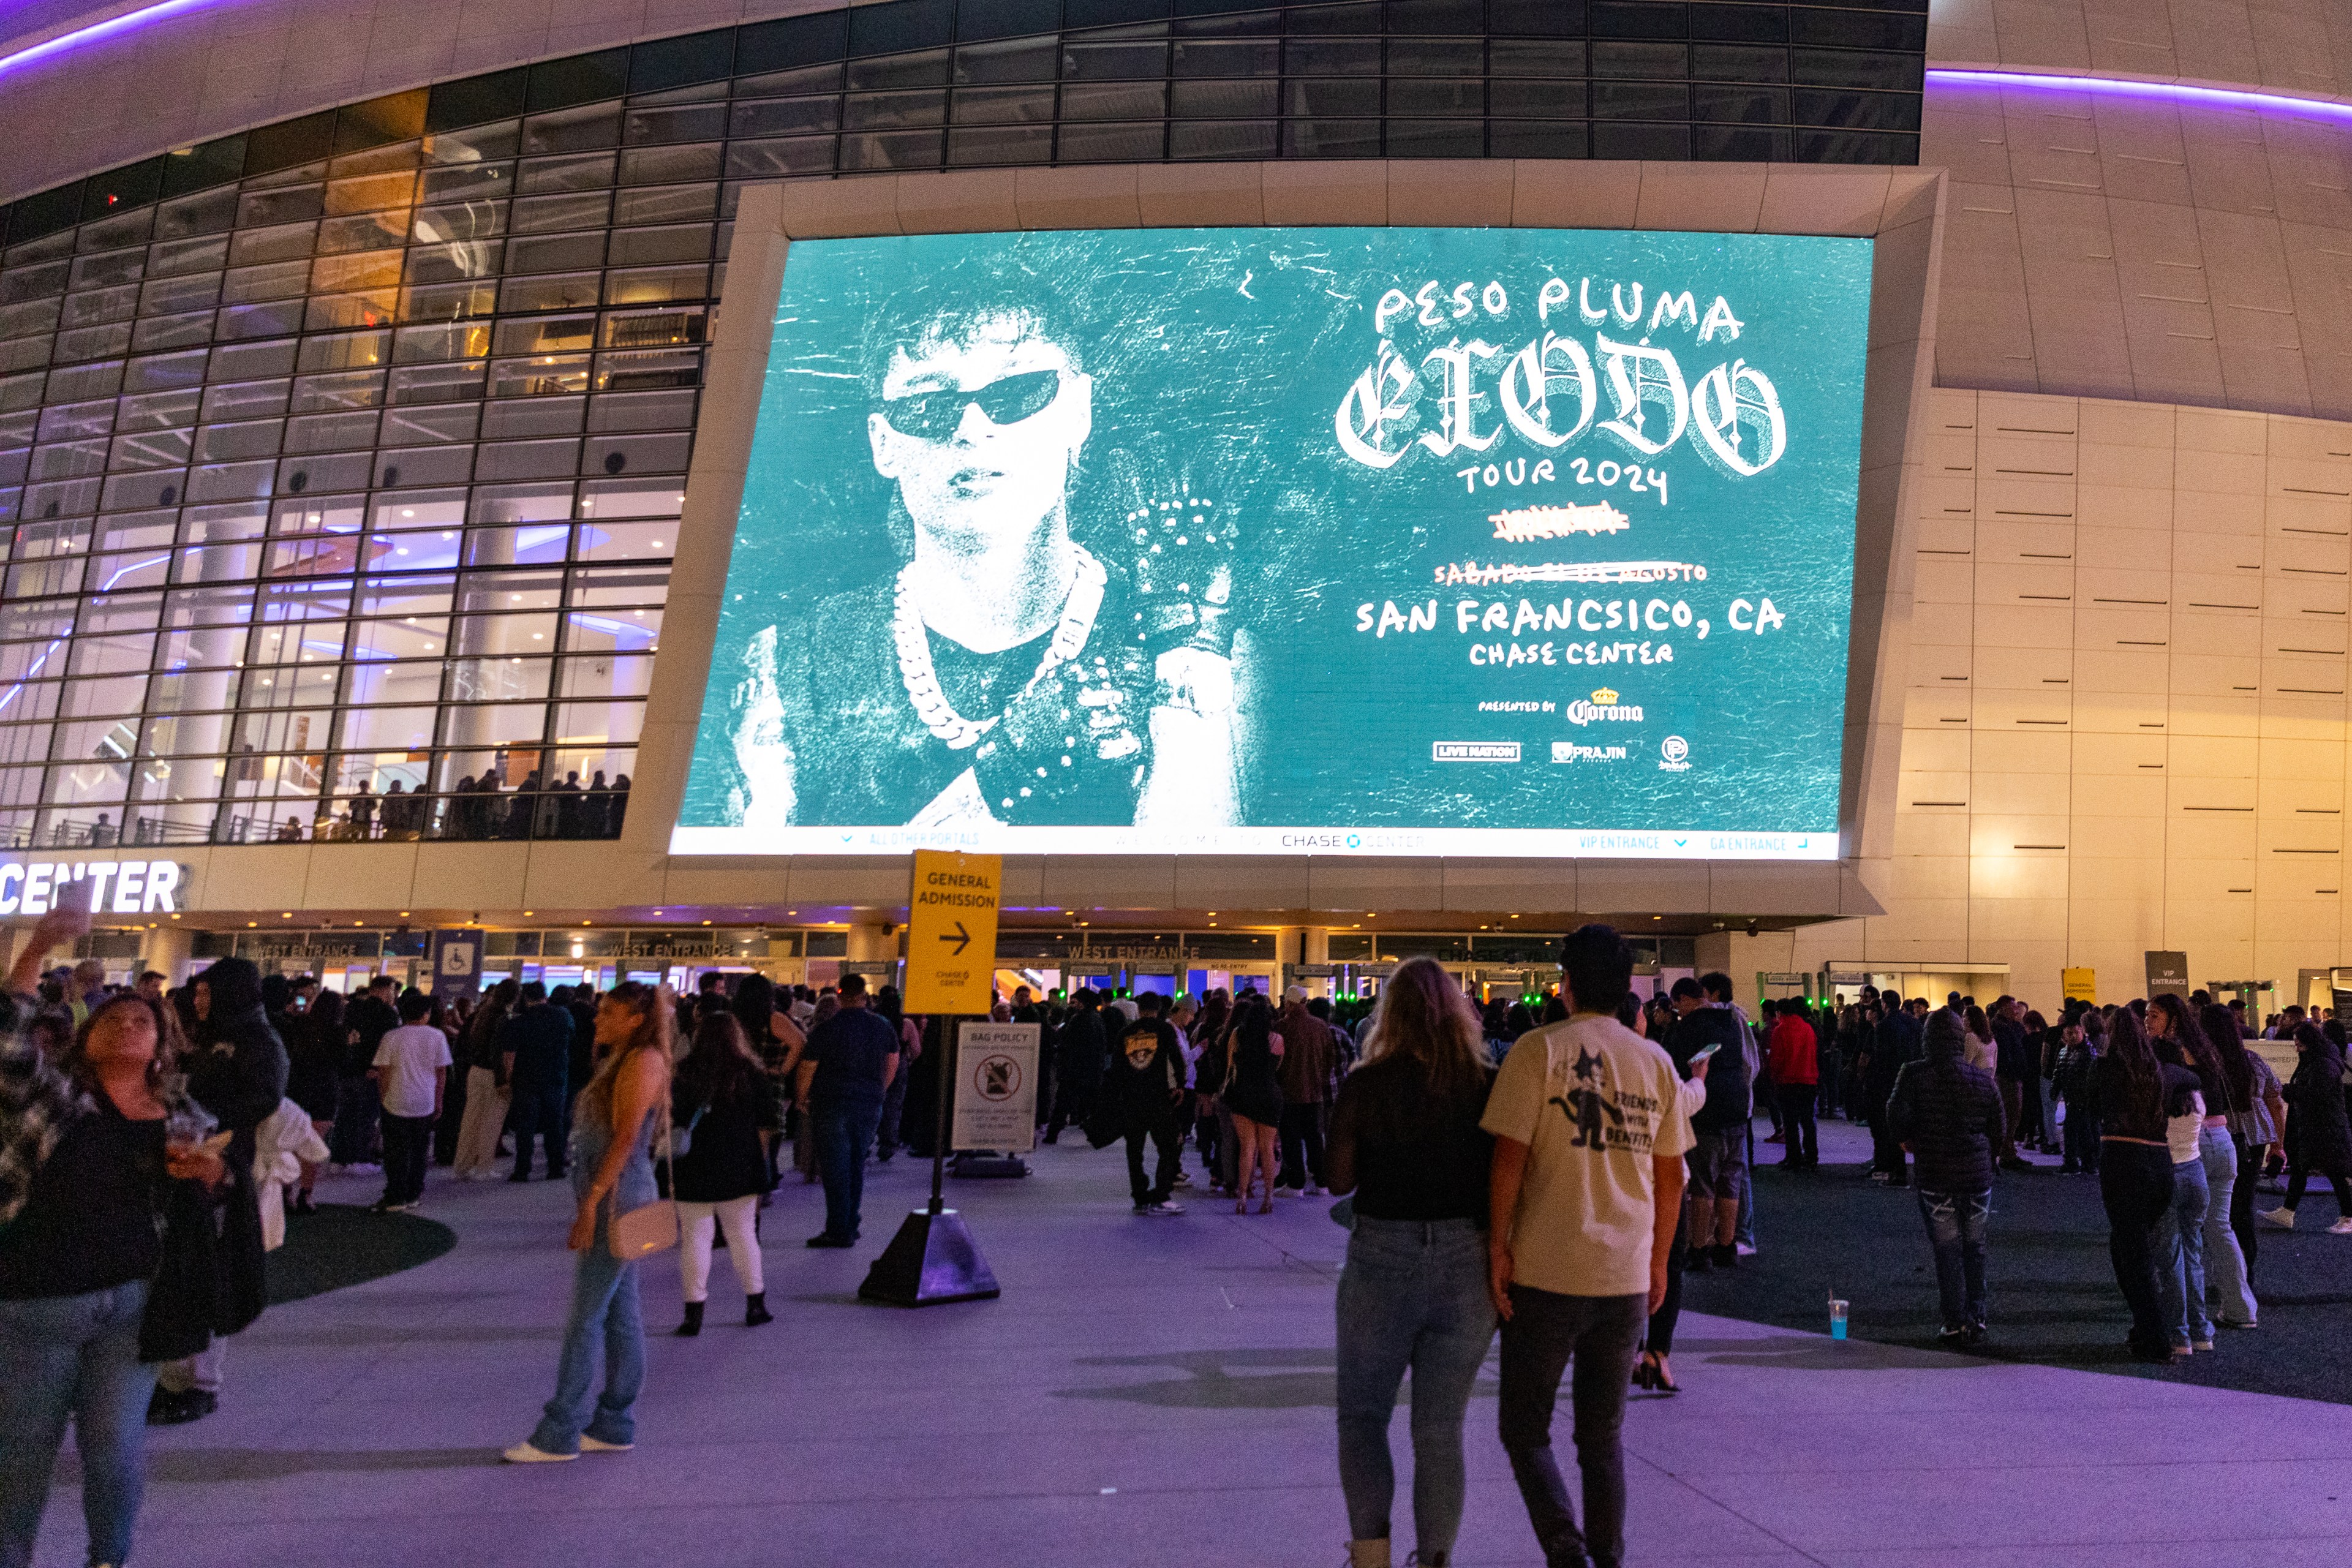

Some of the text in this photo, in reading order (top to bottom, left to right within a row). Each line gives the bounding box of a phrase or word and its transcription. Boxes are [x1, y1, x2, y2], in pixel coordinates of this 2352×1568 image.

[1376, 277, 1746, 342] PESO PLUMA
[1458, 458, 1668, 506] TOUR 2024
[1356, 599, 1438, 638] SAN
[1729, 597, 1785, 636] CA
[1470, 641, 1674, 668] CHASE CENTER
[1478, 699, 1645, 727] PRESENTED BY Corona
[1439, 746, 1517, 758] LIVE NATION
[1572, 746, 1627, 760] PRAJIN
[930, 833, 980, 846] PORTALS
[1282, 835, 1341, 848] CHASE
[1366, 835, 1425, 848] CENTER
[1579, 835, 1660, 850] VIP ENTRANCE
[1710, 837, 1787, 851] GA ENTRANCE
[927, 872, 992, 889] GENERAL
[919, 891, 996, 908] ADMISSION
[1068, 946, 1199, 959] WEST ENTRANCE
[971, 1033, 1028, 1042] BAG POLICY
